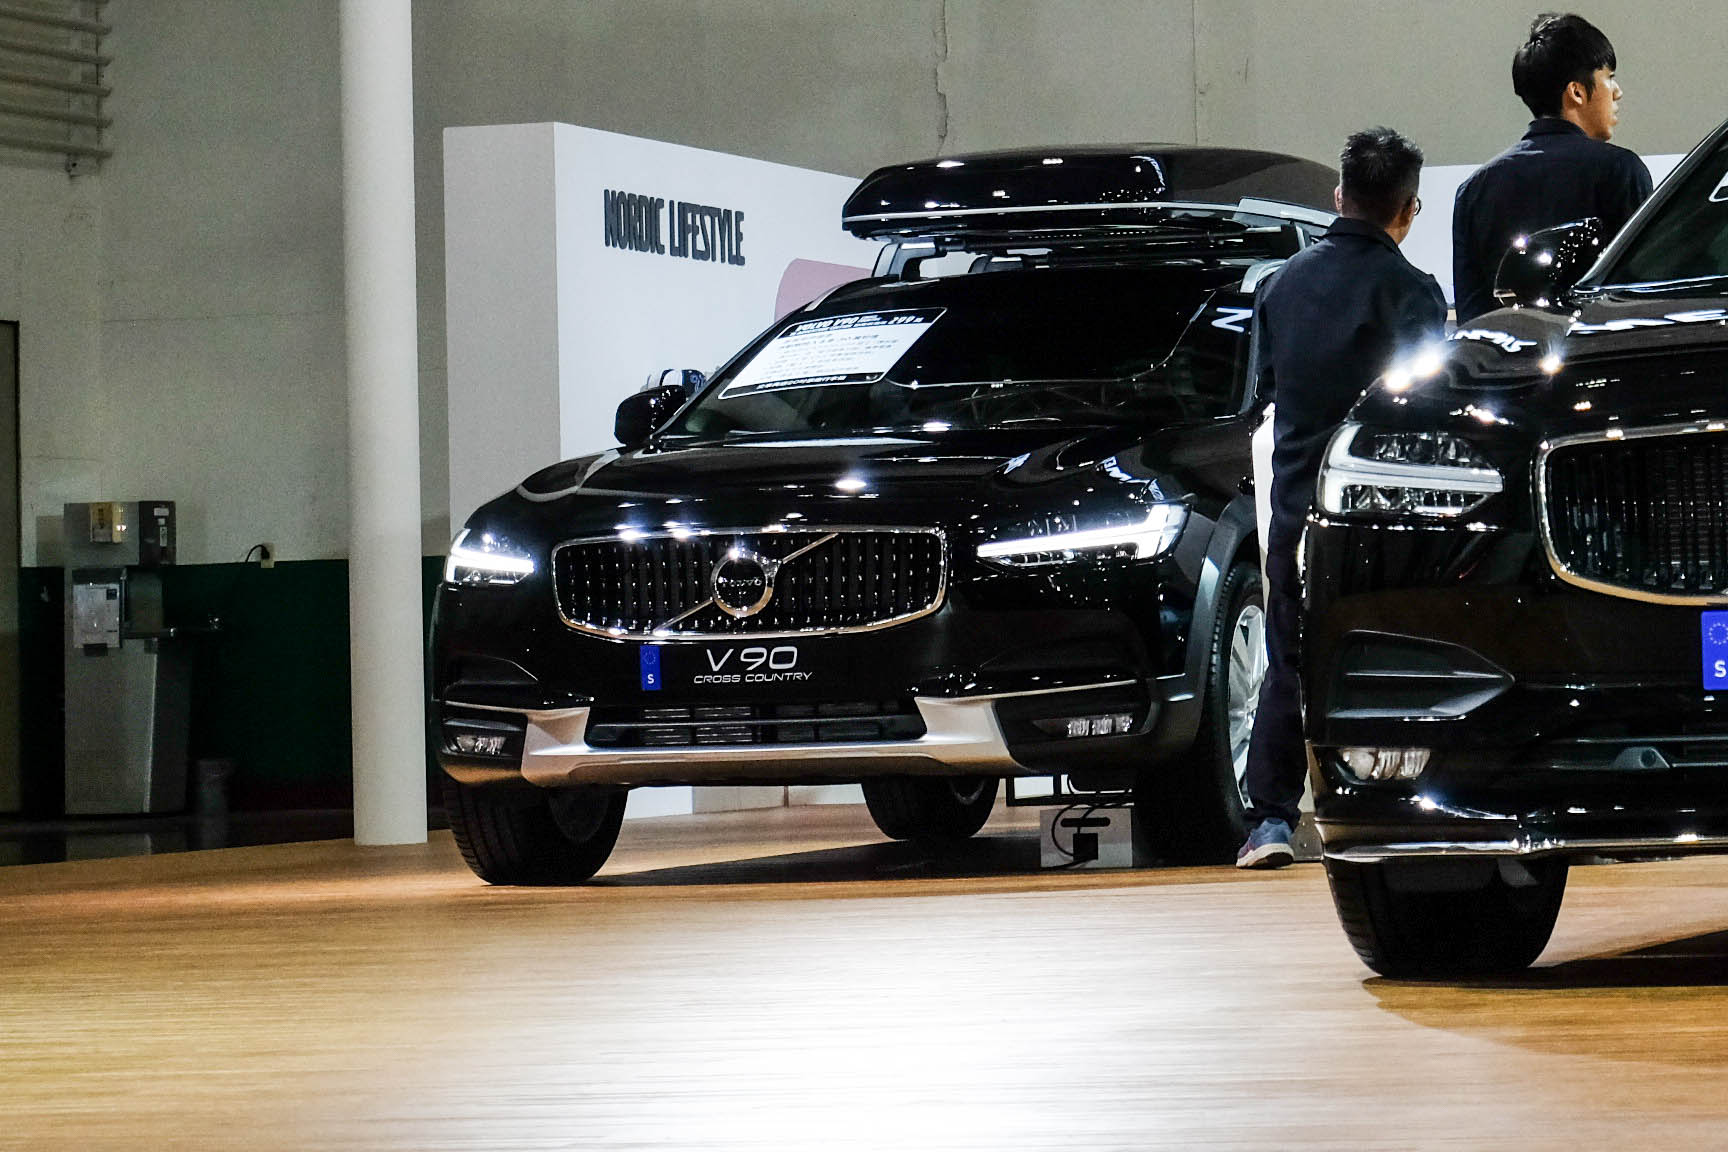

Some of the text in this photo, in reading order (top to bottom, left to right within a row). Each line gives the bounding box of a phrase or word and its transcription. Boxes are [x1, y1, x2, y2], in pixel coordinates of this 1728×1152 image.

[603, 188, 745, 266] NORDIC LIFESTYLE
[1713, 659, 1727, 678] S
[647, 673, 655, 685] S
[693, 671, 813, 684] CROSS COUNTRY
